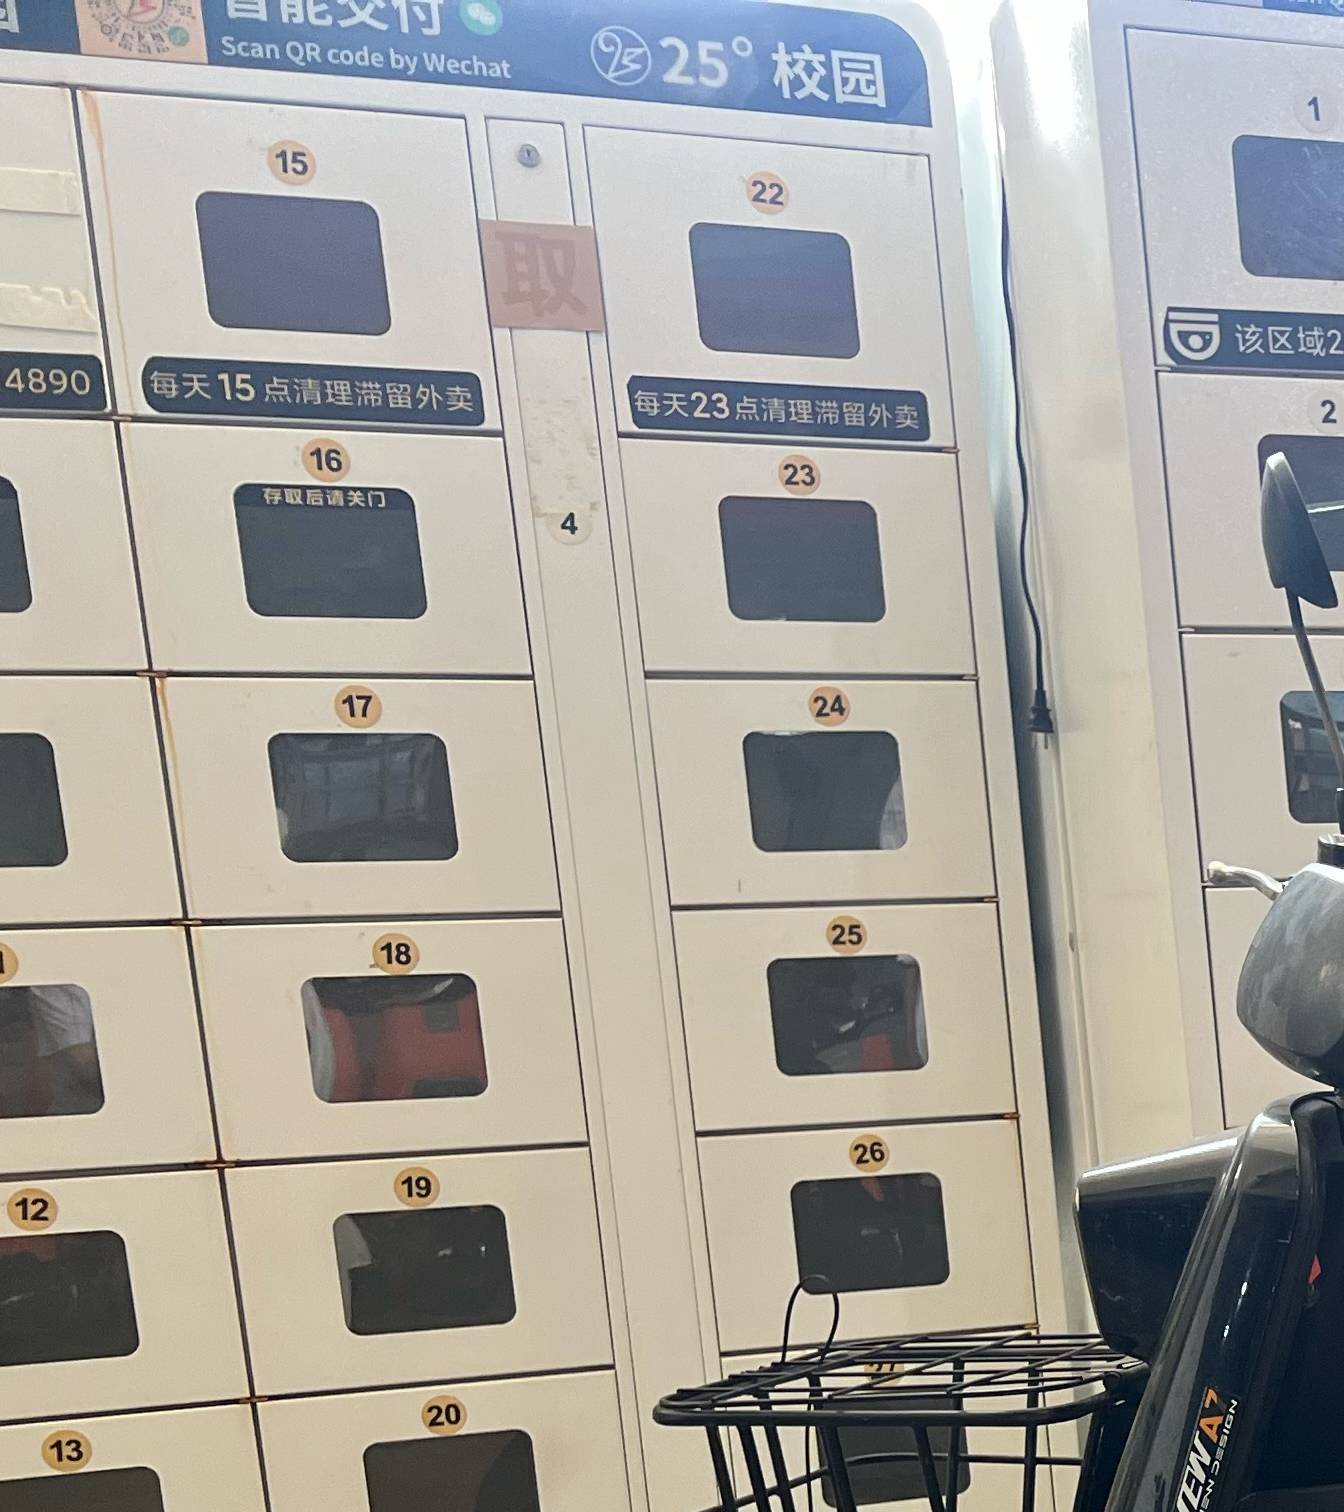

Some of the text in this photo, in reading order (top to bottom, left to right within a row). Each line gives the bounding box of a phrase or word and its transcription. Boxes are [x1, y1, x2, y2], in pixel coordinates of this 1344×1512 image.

[221, 36, 511, 79] Scan QR code by Wechat
[771, 42, 887, 108] 校园
[1308, 96, 1320, 122] 1
[275, 149, 309, 176] 15
[752, 180, 784, 206] 22
[496, 235, 588, 316] 取
[149, 370, 475, 412] 每天15点清理滞留外卖
[634, 390, 920, 429] 每天23点清理滞留外卖
[1321, 400, 1337, 424] 2
[310, 448, 343, 472] 16
[783, 465, 816, 486] 23
[263, 488, 386, 508] 存取后请关门
[561, 512, 578, 534] 4
[342, 695, 372, 719] 17
[813, 695, 845, 718] 24
[831, 922, 862, 946] 25
[380, 942, 411, 966] 18
[853, 1140, 885, 1165] 26
[400, 1176, 432, 1199] 19
[19, 1197, 49, 1221] 12
[427, 1403, 461, 1427] 20
[1211, 1399, 1239, 1476] DESIGN
[50, 1439, 83, 1464] 13
